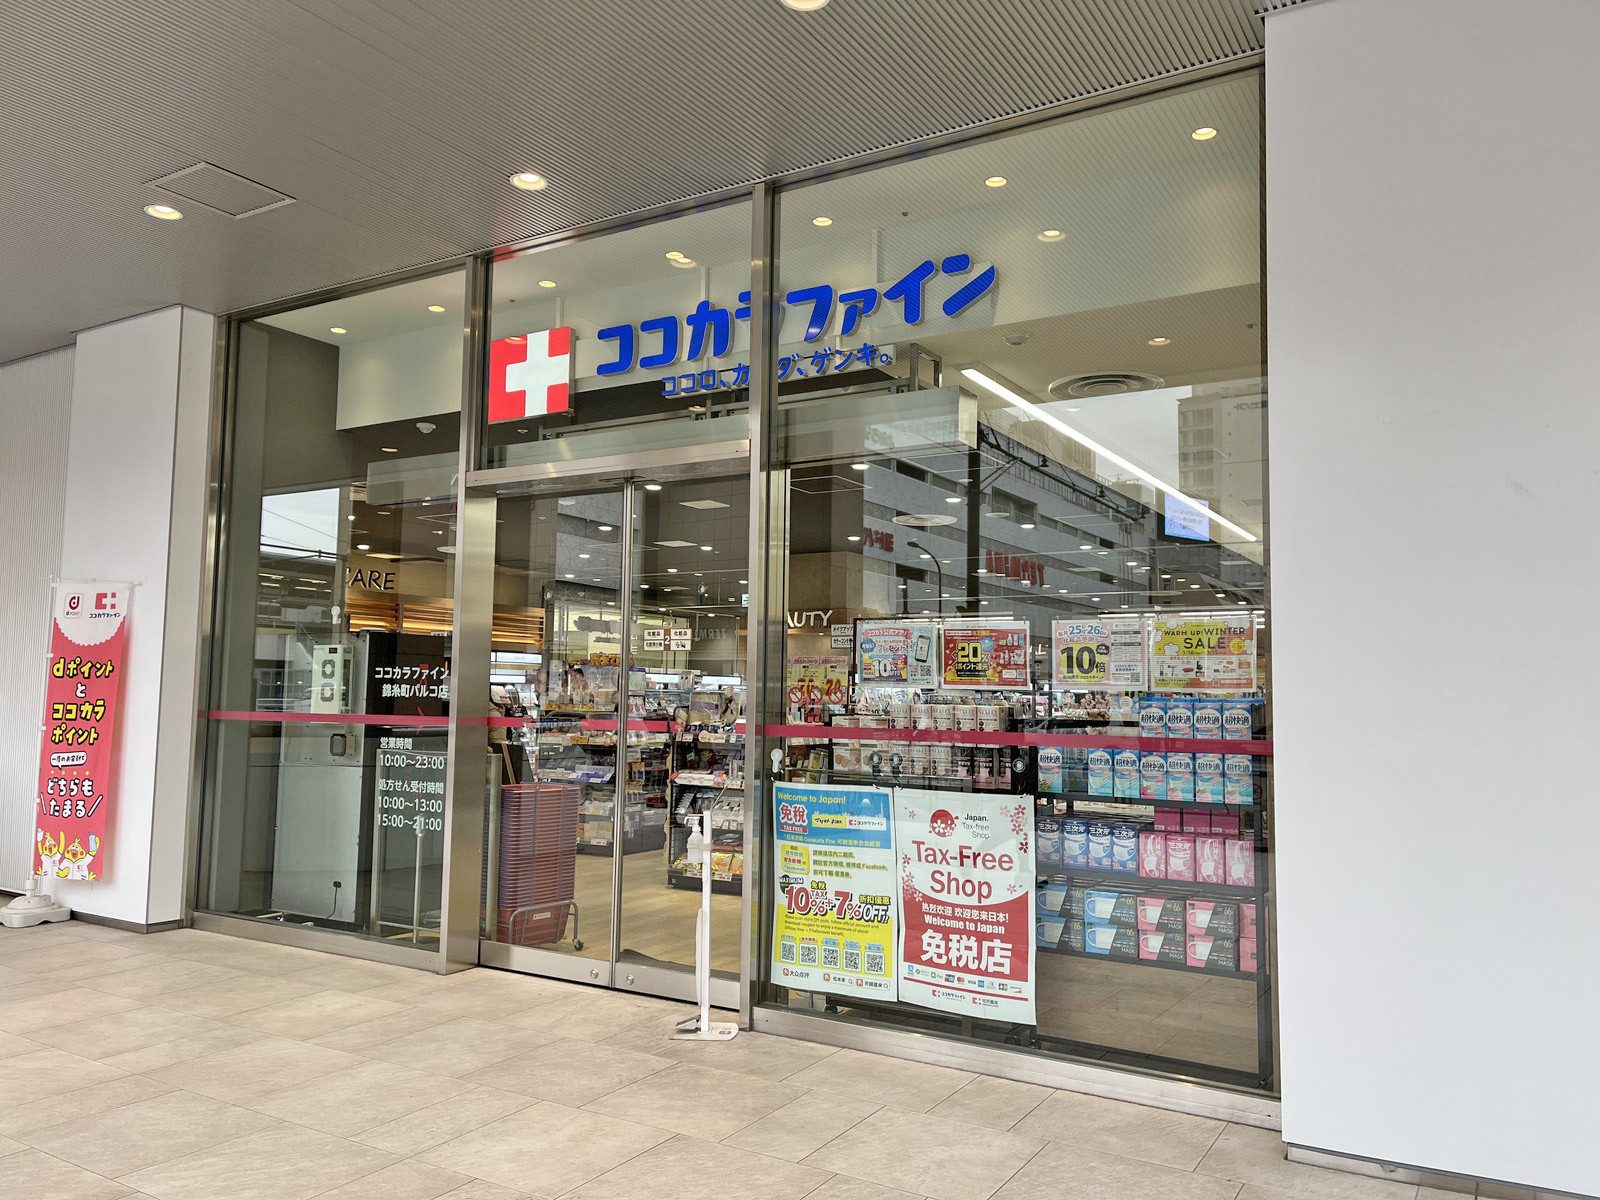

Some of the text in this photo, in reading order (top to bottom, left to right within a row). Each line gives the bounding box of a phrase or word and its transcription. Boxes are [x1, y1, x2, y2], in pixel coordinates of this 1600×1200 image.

[661, 342, 889, 396] ココロ、カダ、ゲンキ。
[1204, 627, 1245, 635] WINTER
[665, 635, 671, 645] 2
[1183, 637, 1226, 649] SALE
[52, 656, 114, 679] dポイント
[375, 666, 449, 680] ココカラファイン
[75, 682, 87, 698] と
[382, 684, 449, 698] 錦糸町パルコ店
[52, 699, 106, 722] ココカラ
[51, 722, 99, 746] ポイント
[380, 737, 413, 750] 営業時間
[47, 777, 94, 797] どちらも
[378, 779, 444, 794] 処方せん受付時間
[777, 792, 847, 805] Welcome to Japan!
[49, 798, 86, 818] たまる
[964, 813, 989, 822] Japan.
[962, 822, 989, 831] Tax-free
[972, 831, 989, 840] Shop
[912, 840, 1014, 871] Tax-Free
[930, 870, 992, 904] Shop
[922, 902, 953, 916] 热烈欢迎
[924, 914, 1005, 934] Welcome to Japan
[920, 928, 1013, 975] 免税店
